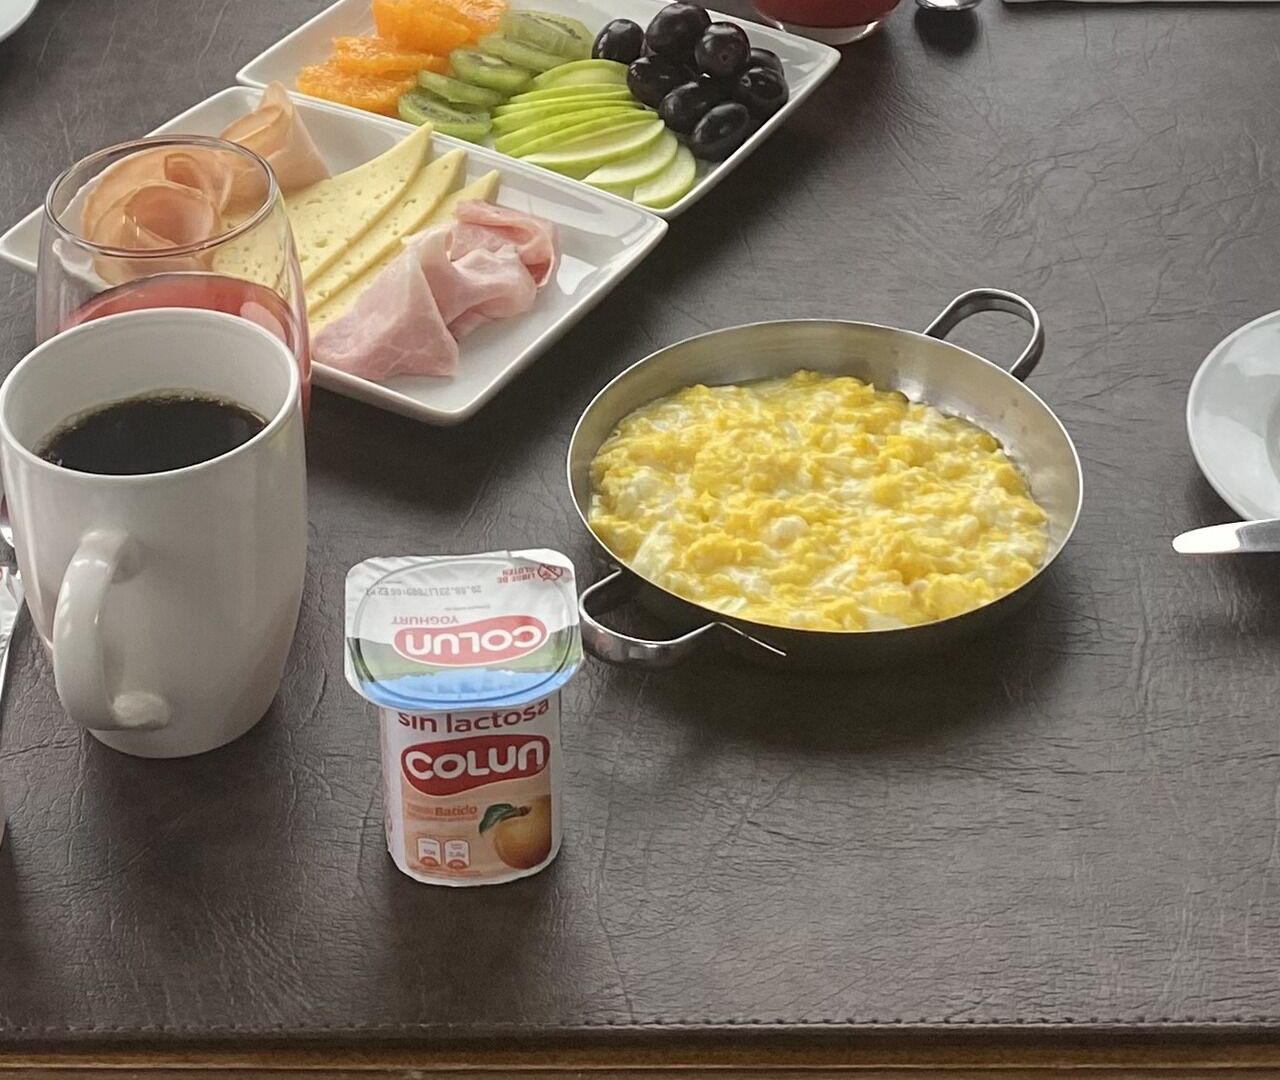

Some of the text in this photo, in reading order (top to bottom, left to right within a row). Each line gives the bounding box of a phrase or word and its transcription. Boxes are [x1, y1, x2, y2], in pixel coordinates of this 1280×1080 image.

[391, 615, 458, 626] YOGHURT
[406, 624, 542, 656] COLUN
[398, 699, 549, 733] sin lactosa
[405, 740, 544, 780] COLUN
[434, 804, 478, 817] Batido
